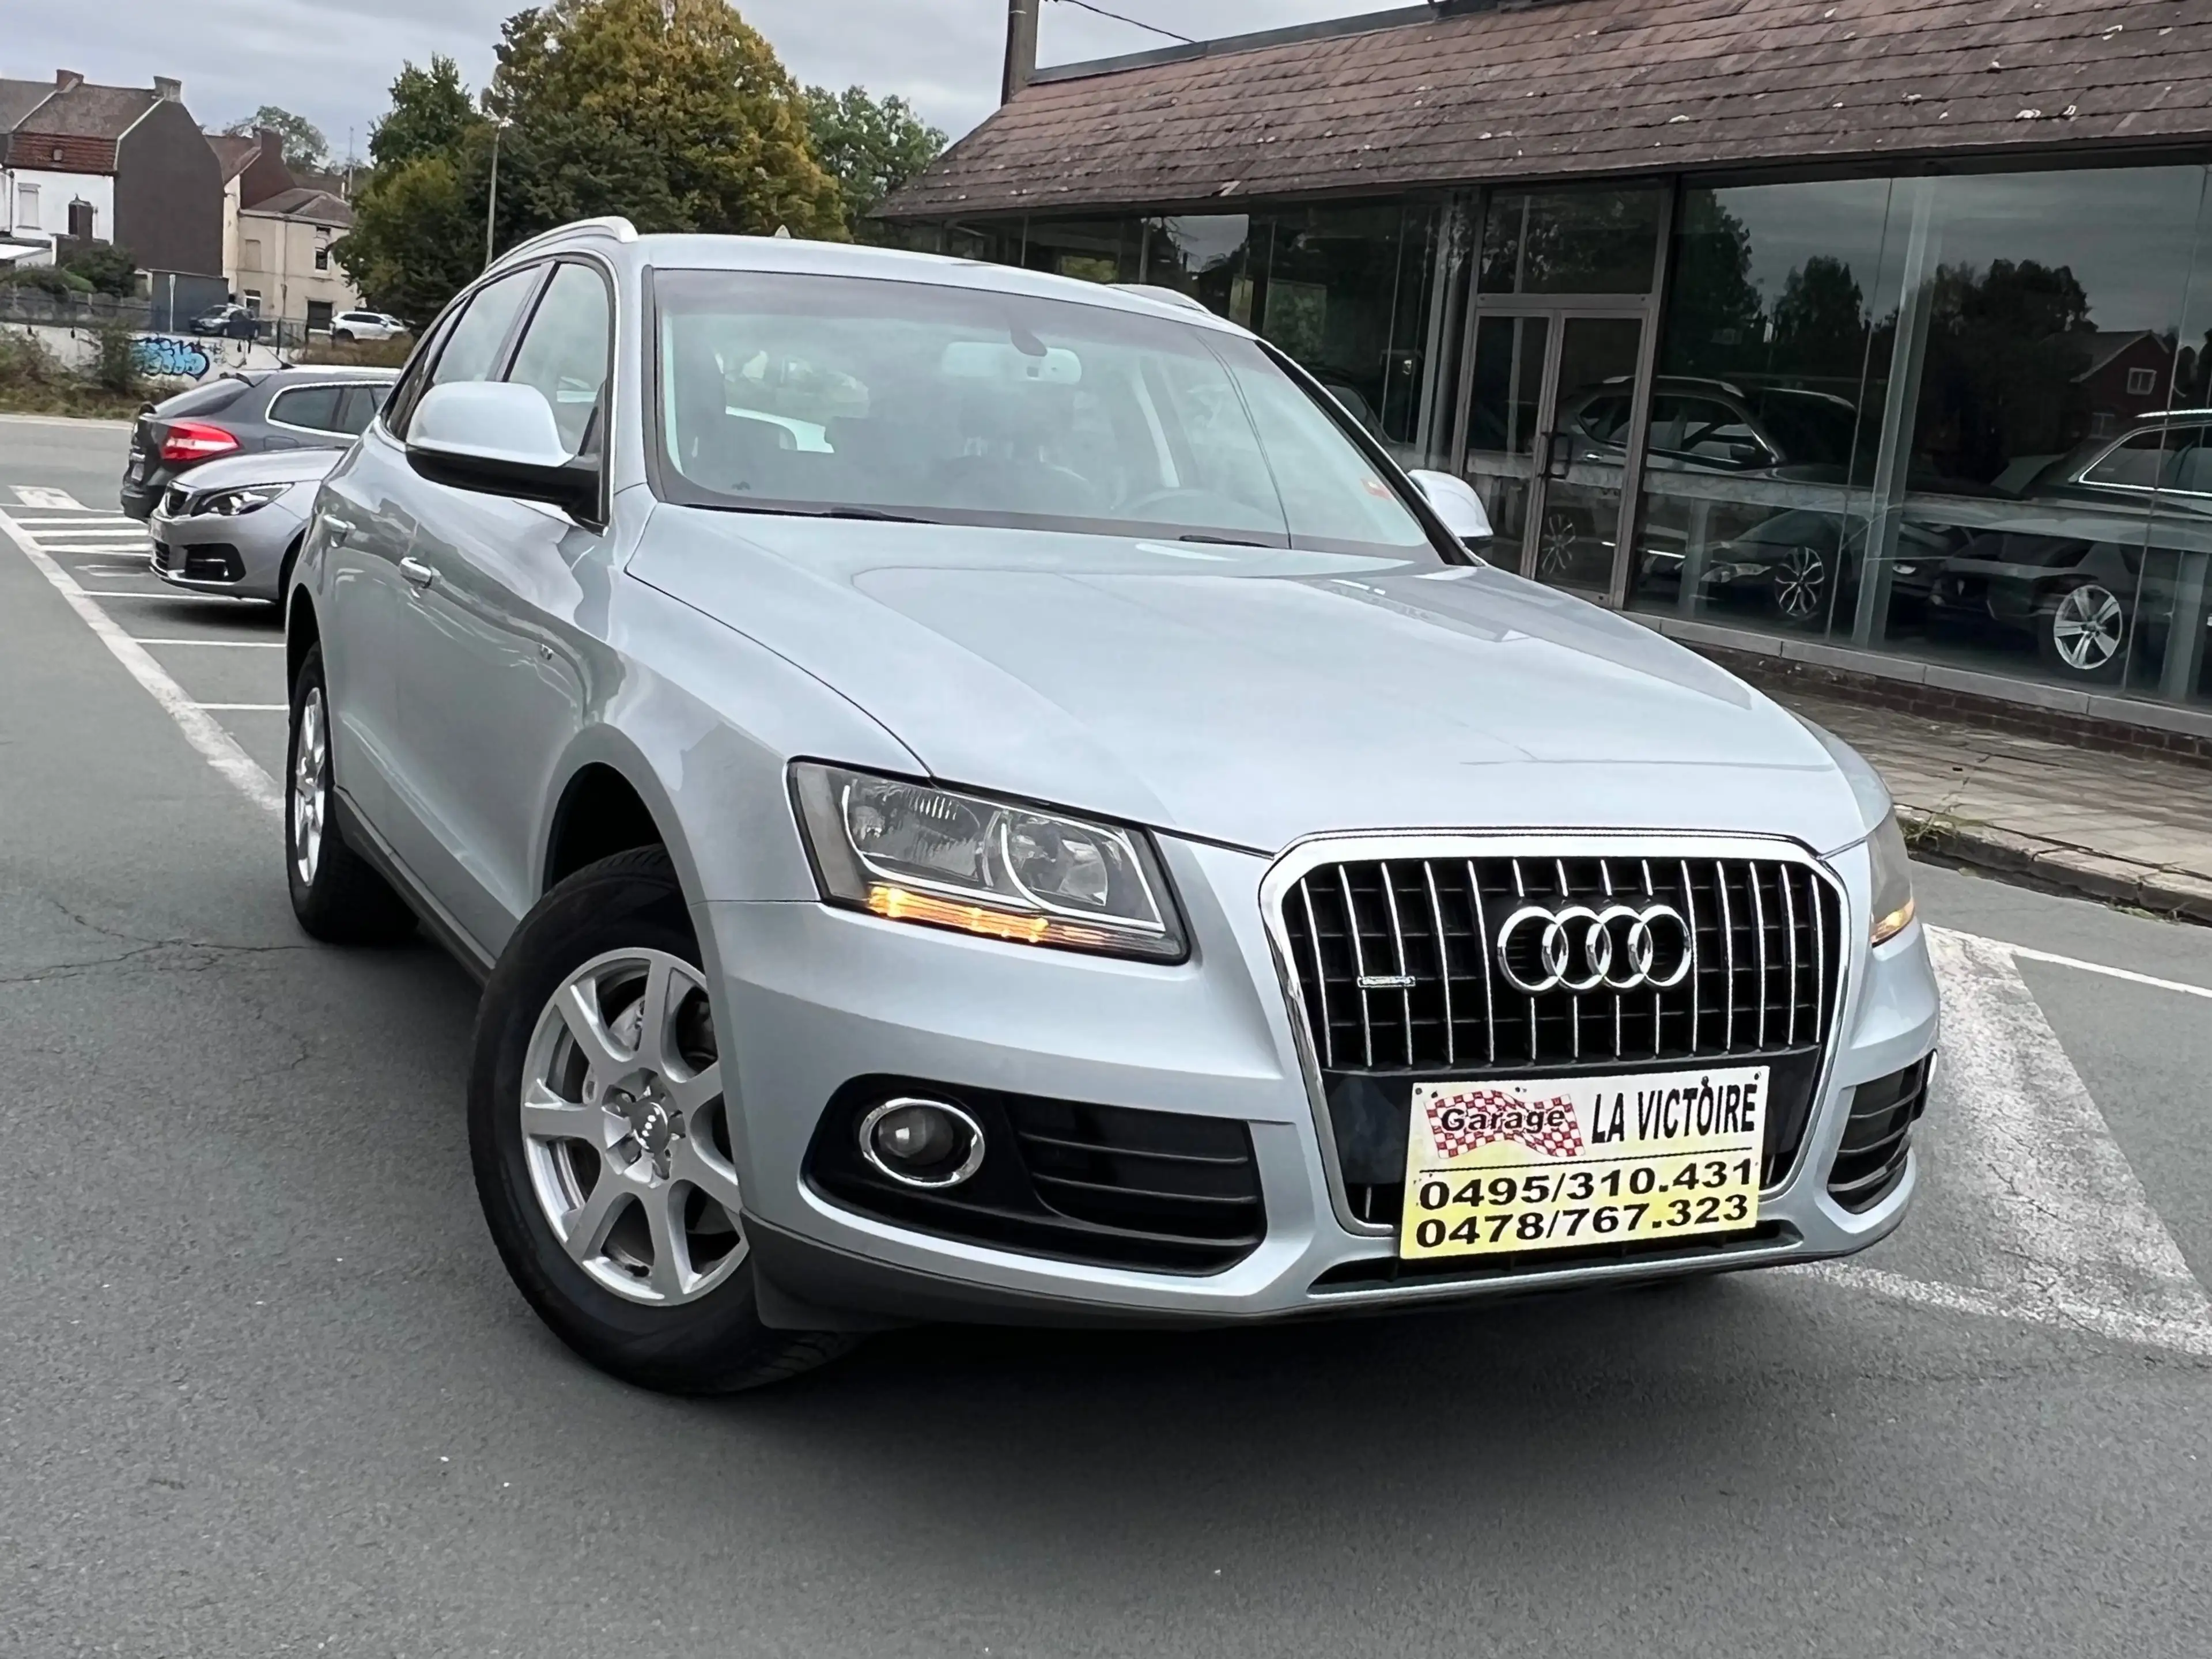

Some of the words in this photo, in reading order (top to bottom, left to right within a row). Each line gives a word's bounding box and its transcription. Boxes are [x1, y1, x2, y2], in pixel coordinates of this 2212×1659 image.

[1441, 1108, 1566, 1134] Garage
[1591, 1092, 1625, 1144] LA
[1638, 1084, 1758, 1141] VICTOIRE
[1419, 1158, 1752, 1210] 0495/310.431
[1416, 1194, 1748, 1248] 0478/767.323
